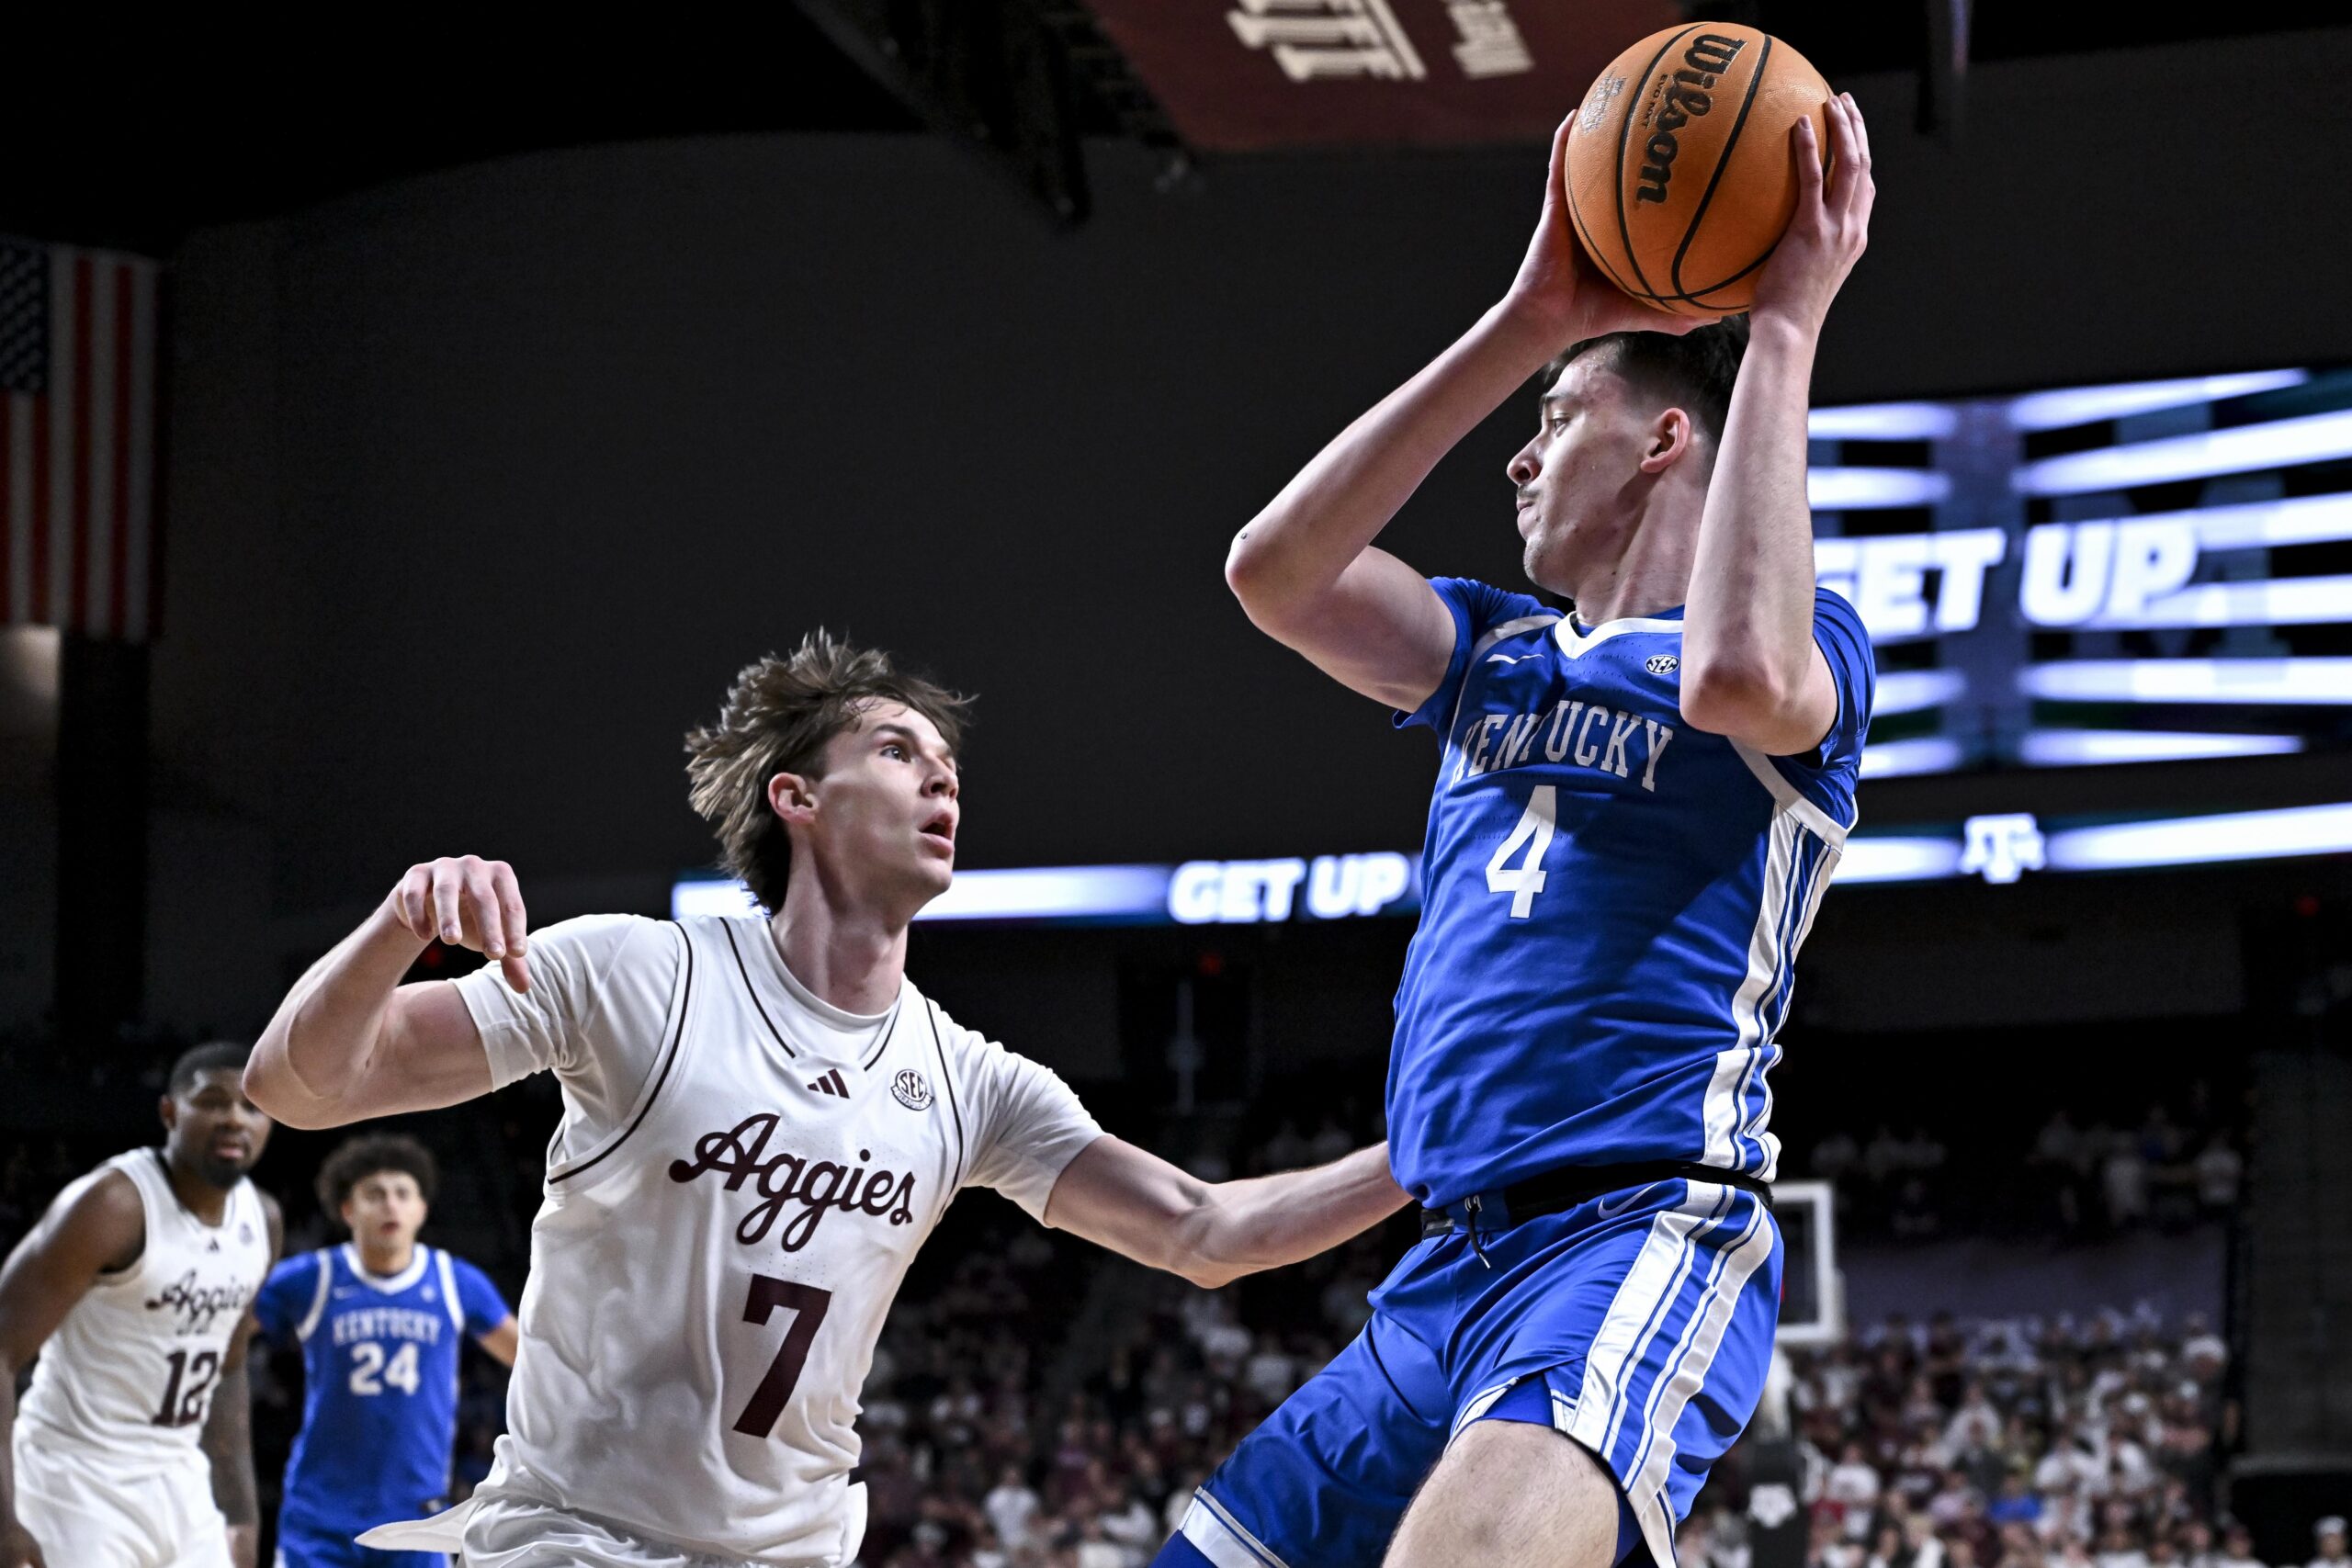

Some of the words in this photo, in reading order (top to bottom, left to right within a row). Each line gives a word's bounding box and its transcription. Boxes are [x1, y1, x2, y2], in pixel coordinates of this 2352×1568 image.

[1636, 34, 1747, 203] Wilson
[1652, 73, 1668, 99] EVO
[2019, 520, 2200, 627] UP
[1647, 656, 1678, 673] SEC
[1168, 857, 1306, 923] GET
[1306, 852, 1411, 919] UP
[1485, 784, 1556, 919] 4
[899, 1071, 924, 1099] SEC
[668, 1112, 917, 1253] Aggies
[333, 1306, 441, 1347] KENTUCKY
[732, 1272, 832, 1438] 7
[152, 1348, 218, 1427] 12
[349, 1340, 421, 1396] 24
